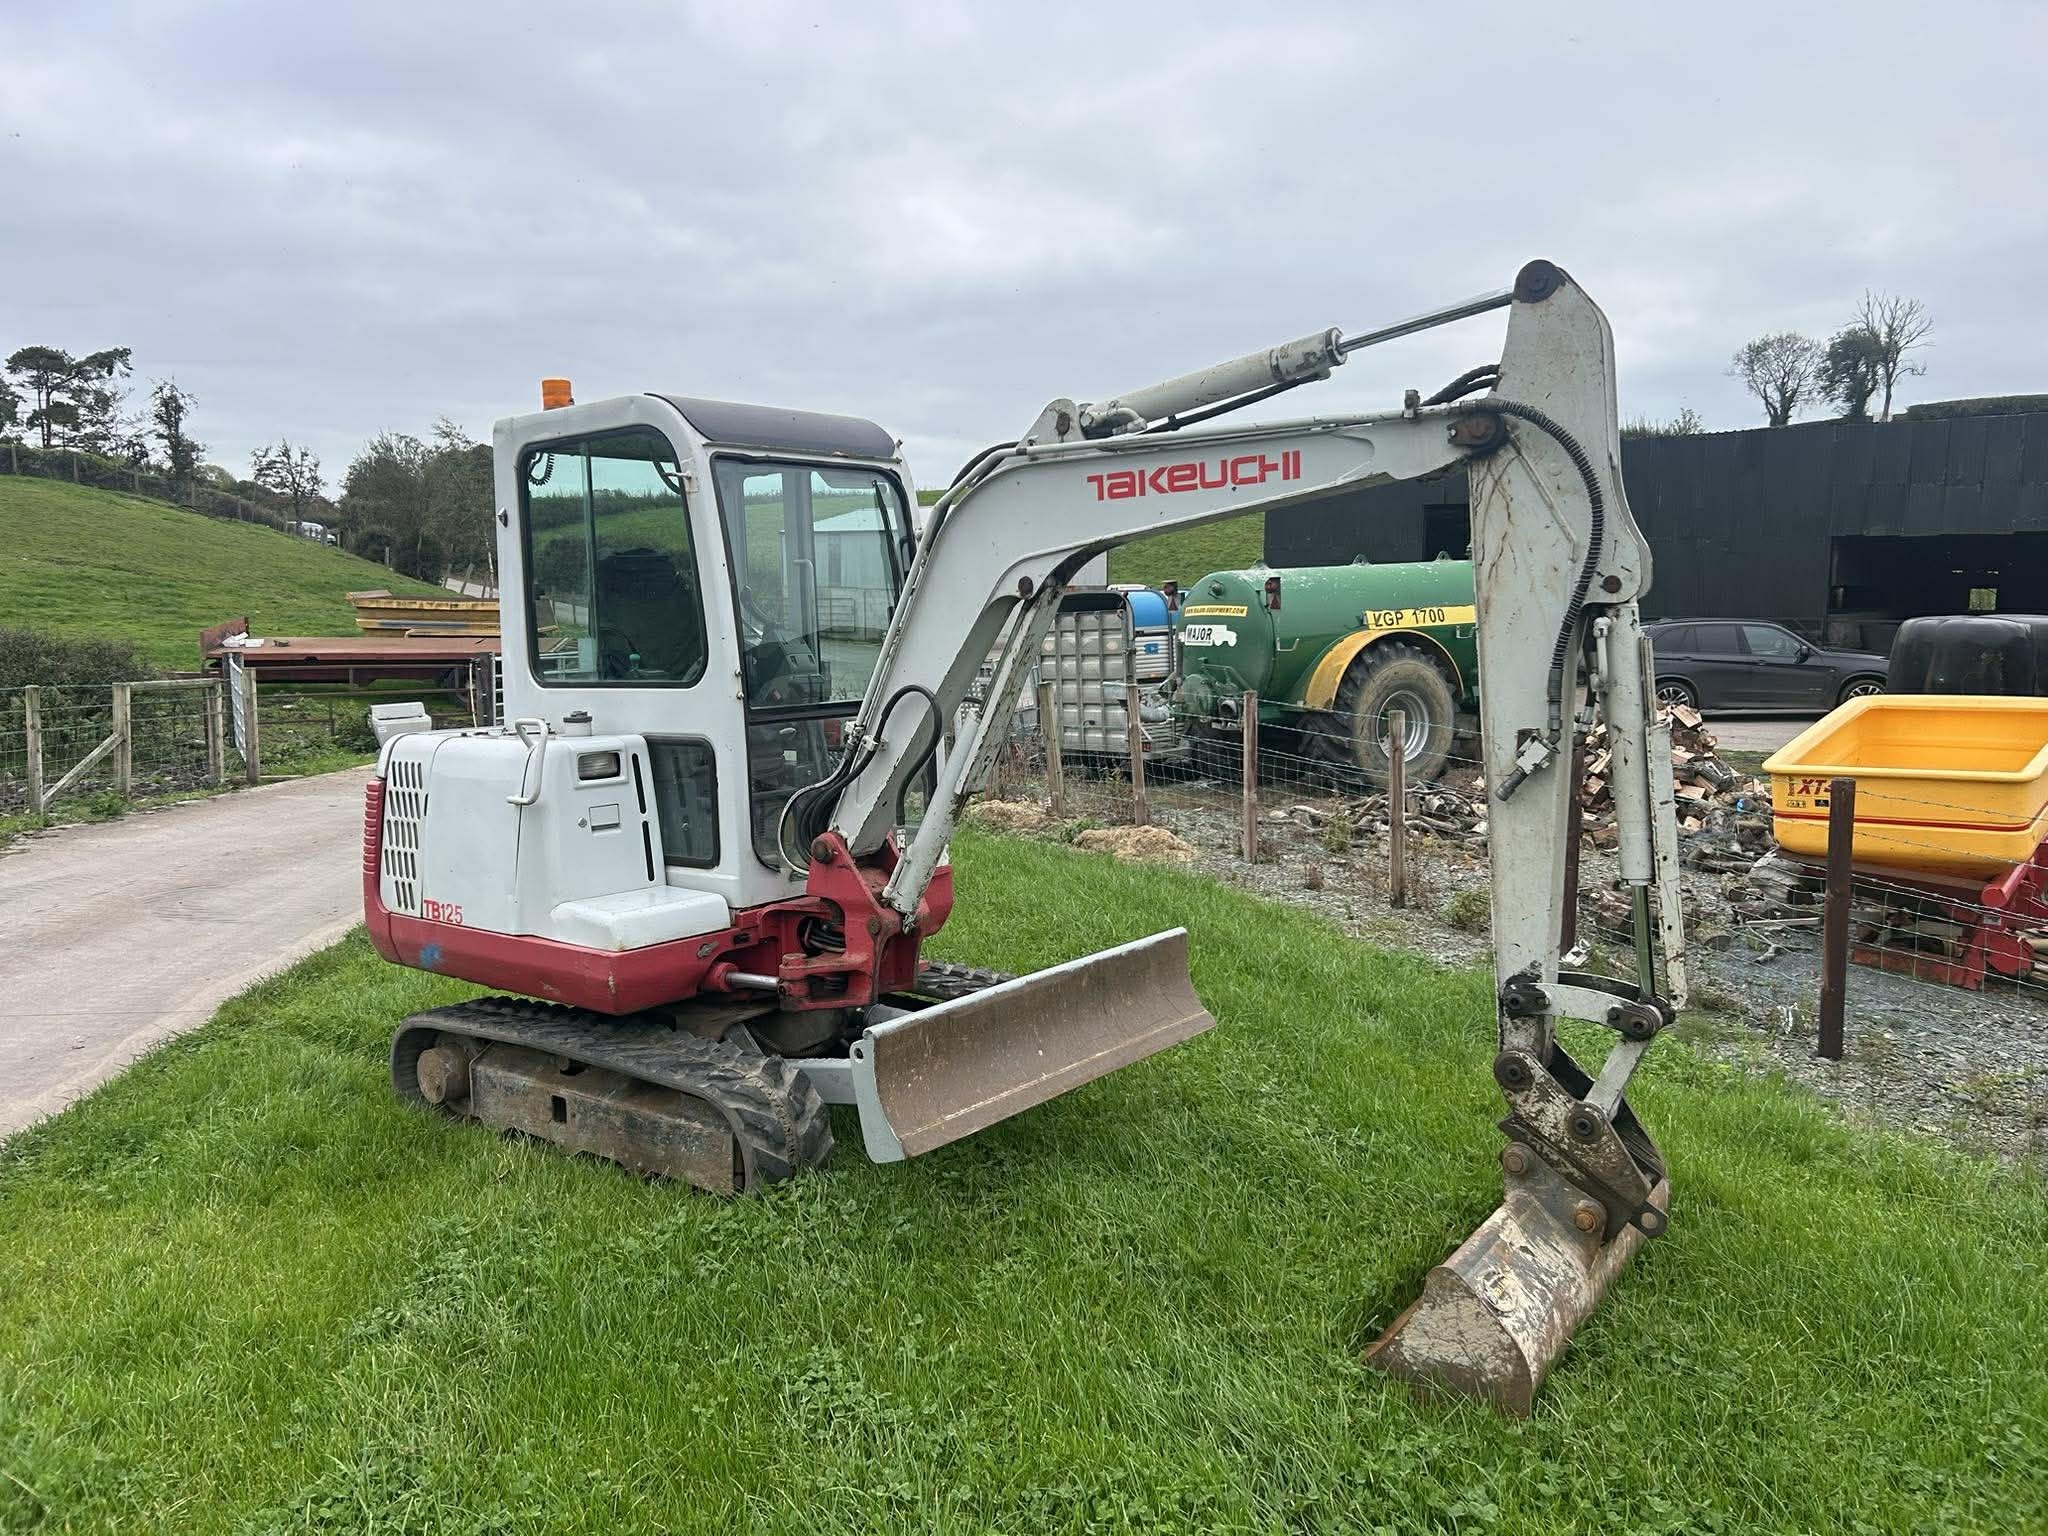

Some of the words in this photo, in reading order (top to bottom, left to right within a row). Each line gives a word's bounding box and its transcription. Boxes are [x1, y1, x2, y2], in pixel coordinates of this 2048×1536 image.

[1087, 450, 1301, 501] TAKEUCHI
[1412, 608, 1445, 625] 1700
[1187, 627, 1213, 641] MAJOR
[424, 899, 463, 924] TB125
